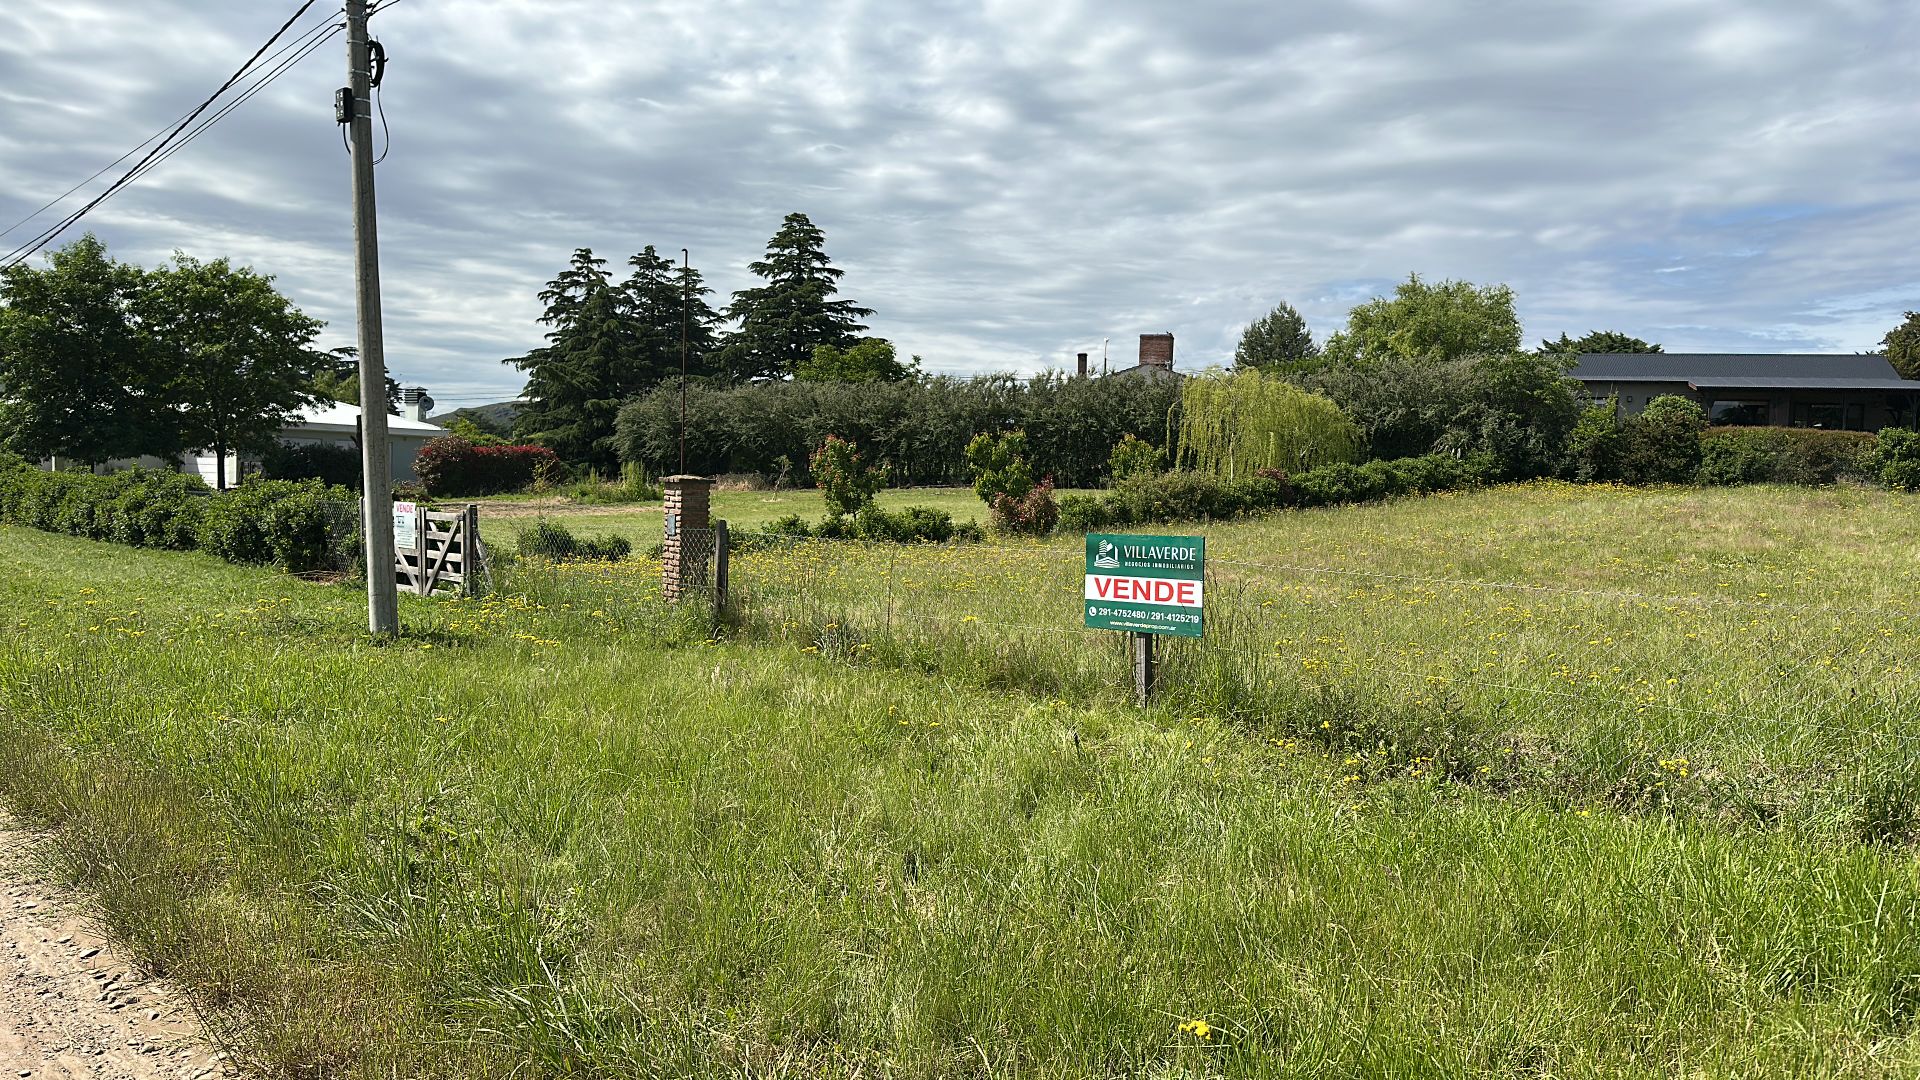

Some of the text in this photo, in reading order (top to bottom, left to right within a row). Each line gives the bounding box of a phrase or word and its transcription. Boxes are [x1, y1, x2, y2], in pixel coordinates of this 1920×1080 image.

[396, 503, 413, 513] VENDE
[1123, 545, 1196, 561] VILLAVERDE
[1094, 577, 1195, 604] VENDE
[1099, 607, 1146, 619] 291-4752480
[1151, 612, 1199, 623] 291-4125219
